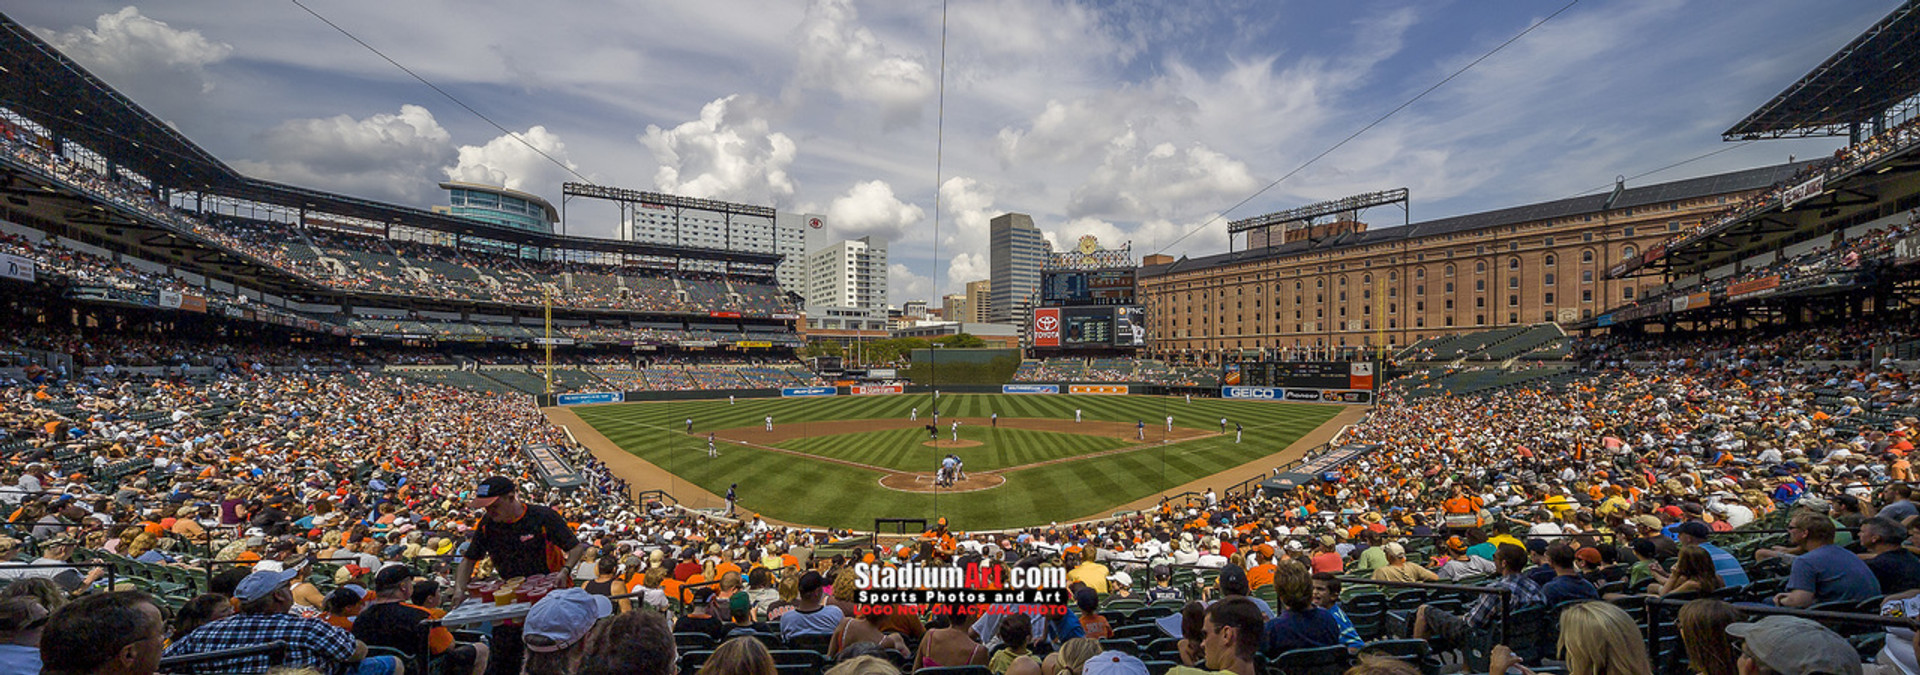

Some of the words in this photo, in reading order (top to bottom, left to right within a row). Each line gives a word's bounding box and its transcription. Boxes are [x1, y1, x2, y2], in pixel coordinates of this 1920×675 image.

[1126, 307, 1144, 315] PNC
[1035, 331, 1059, 339] TOYOTA
[1230, 388, 1275, 399] GEICO
[1286, 391, 1319, 399] Pioneer
